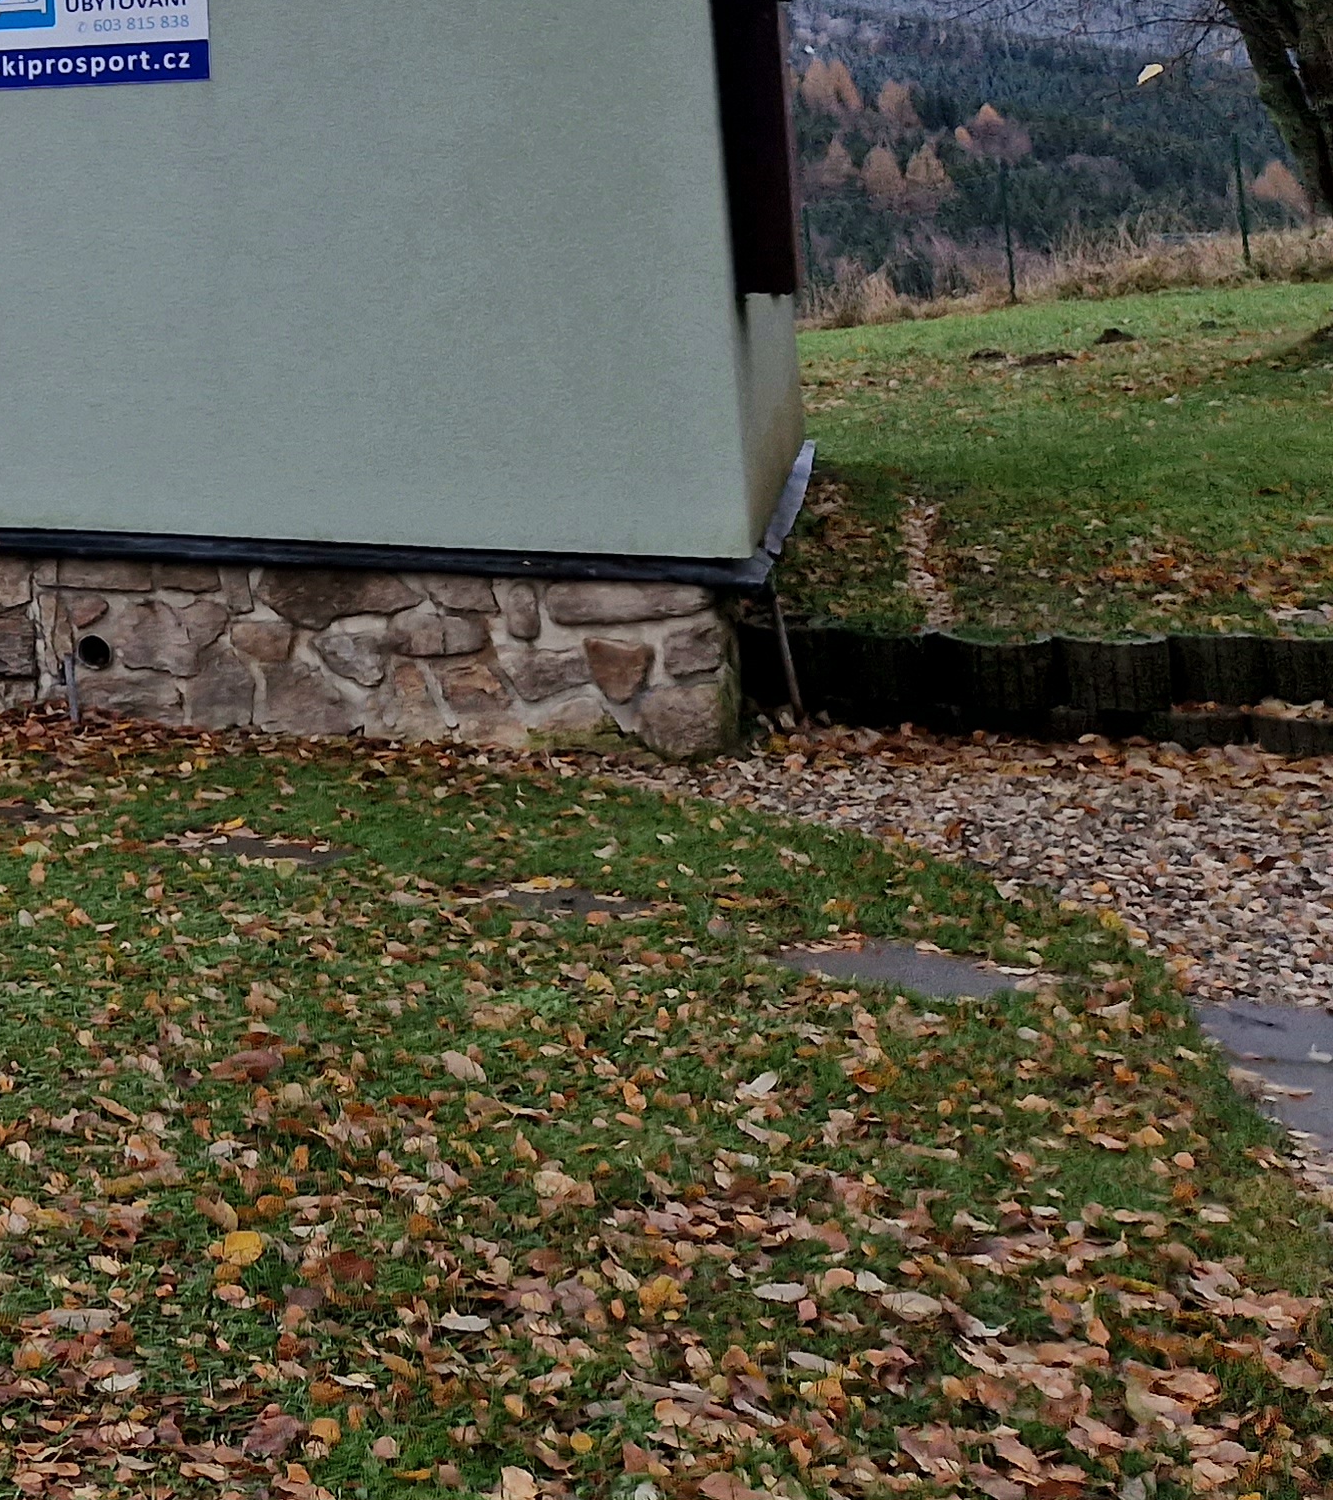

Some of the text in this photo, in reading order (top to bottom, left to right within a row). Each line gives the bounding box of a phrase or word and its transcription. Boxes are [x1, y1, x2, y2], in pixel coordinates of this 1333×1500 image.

[93, 14, 189, 32] 603 815 838
